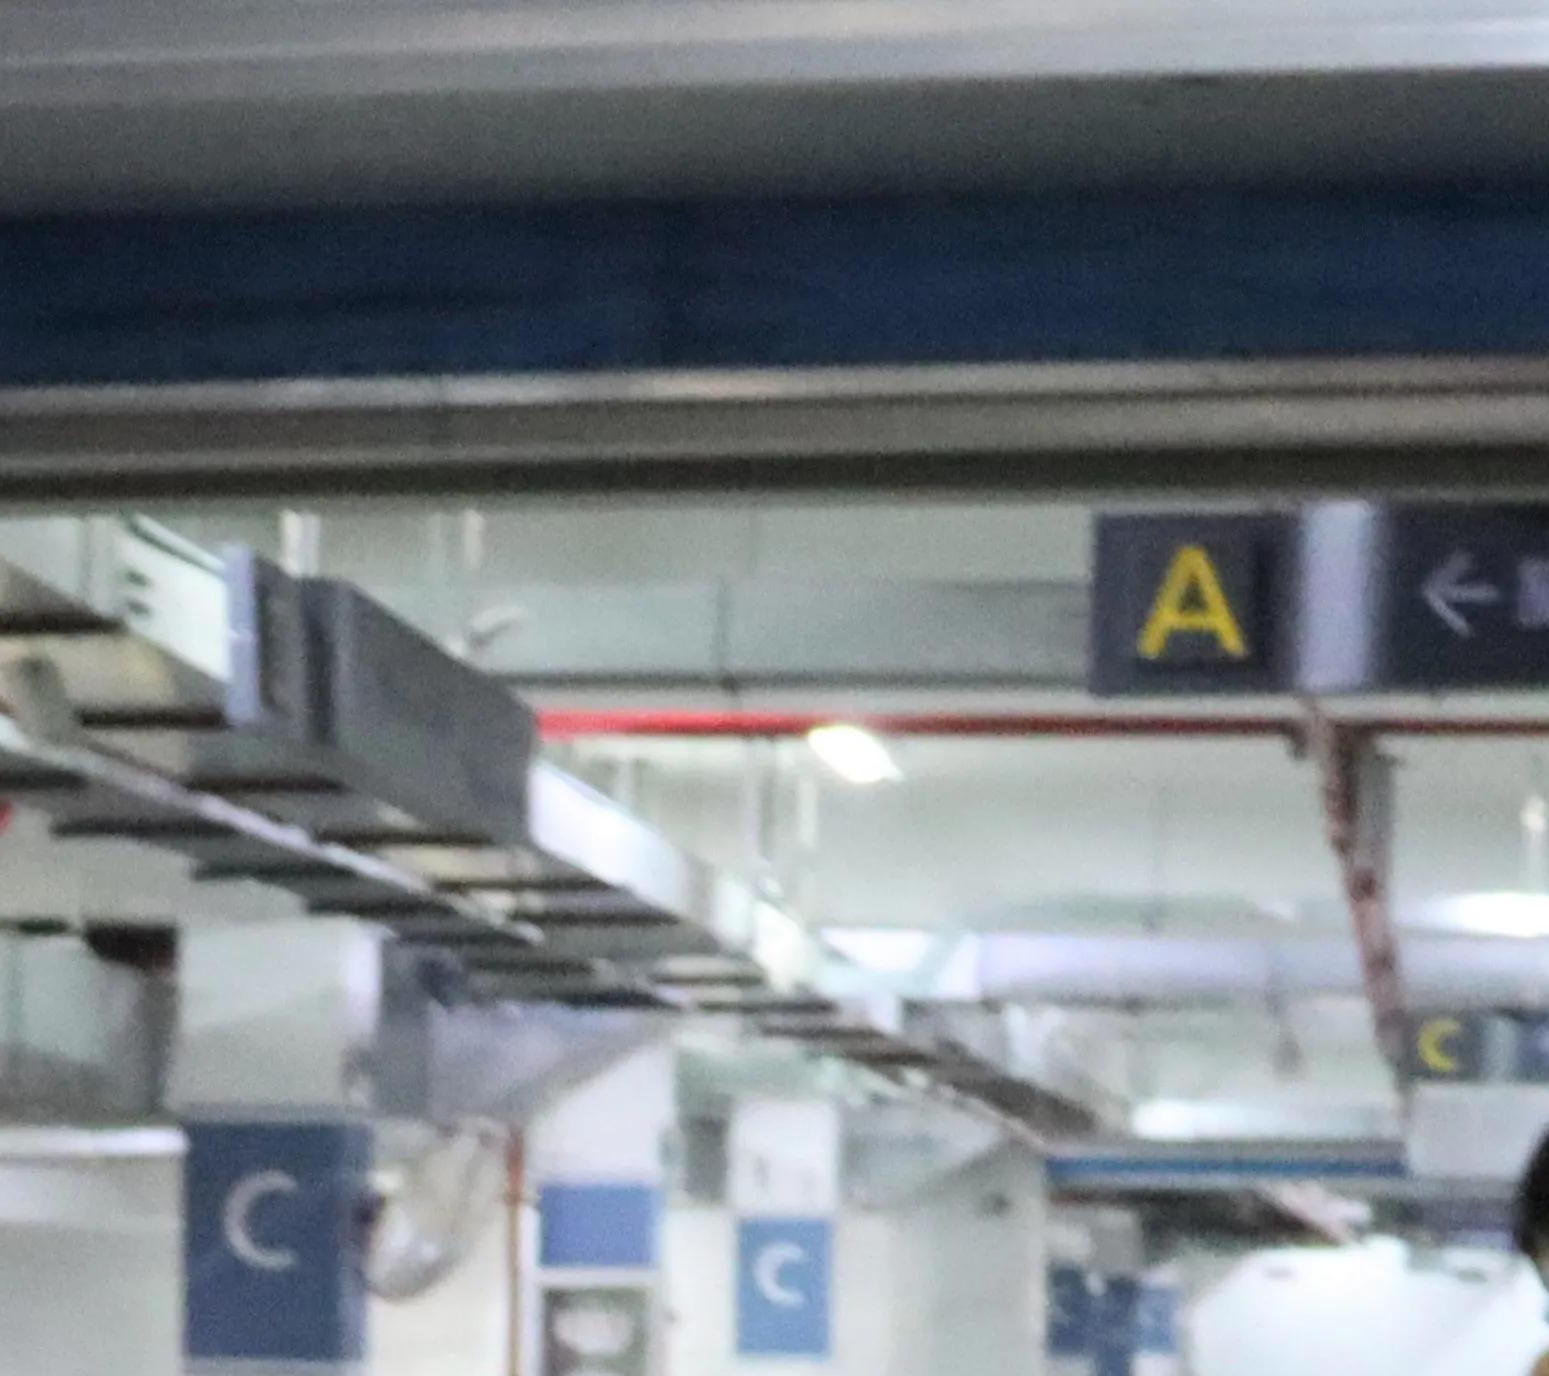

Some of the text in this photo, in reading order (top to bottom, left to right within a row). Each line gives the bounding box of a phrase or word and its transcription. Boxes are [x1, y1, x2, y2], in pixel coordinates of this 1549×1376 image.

[1138, 544, 1247, 658] A
[1419, 1017, 1462, 1072] C
[223, 1168, 299, 1273] C
[754, 1240, 804, 1308] C
